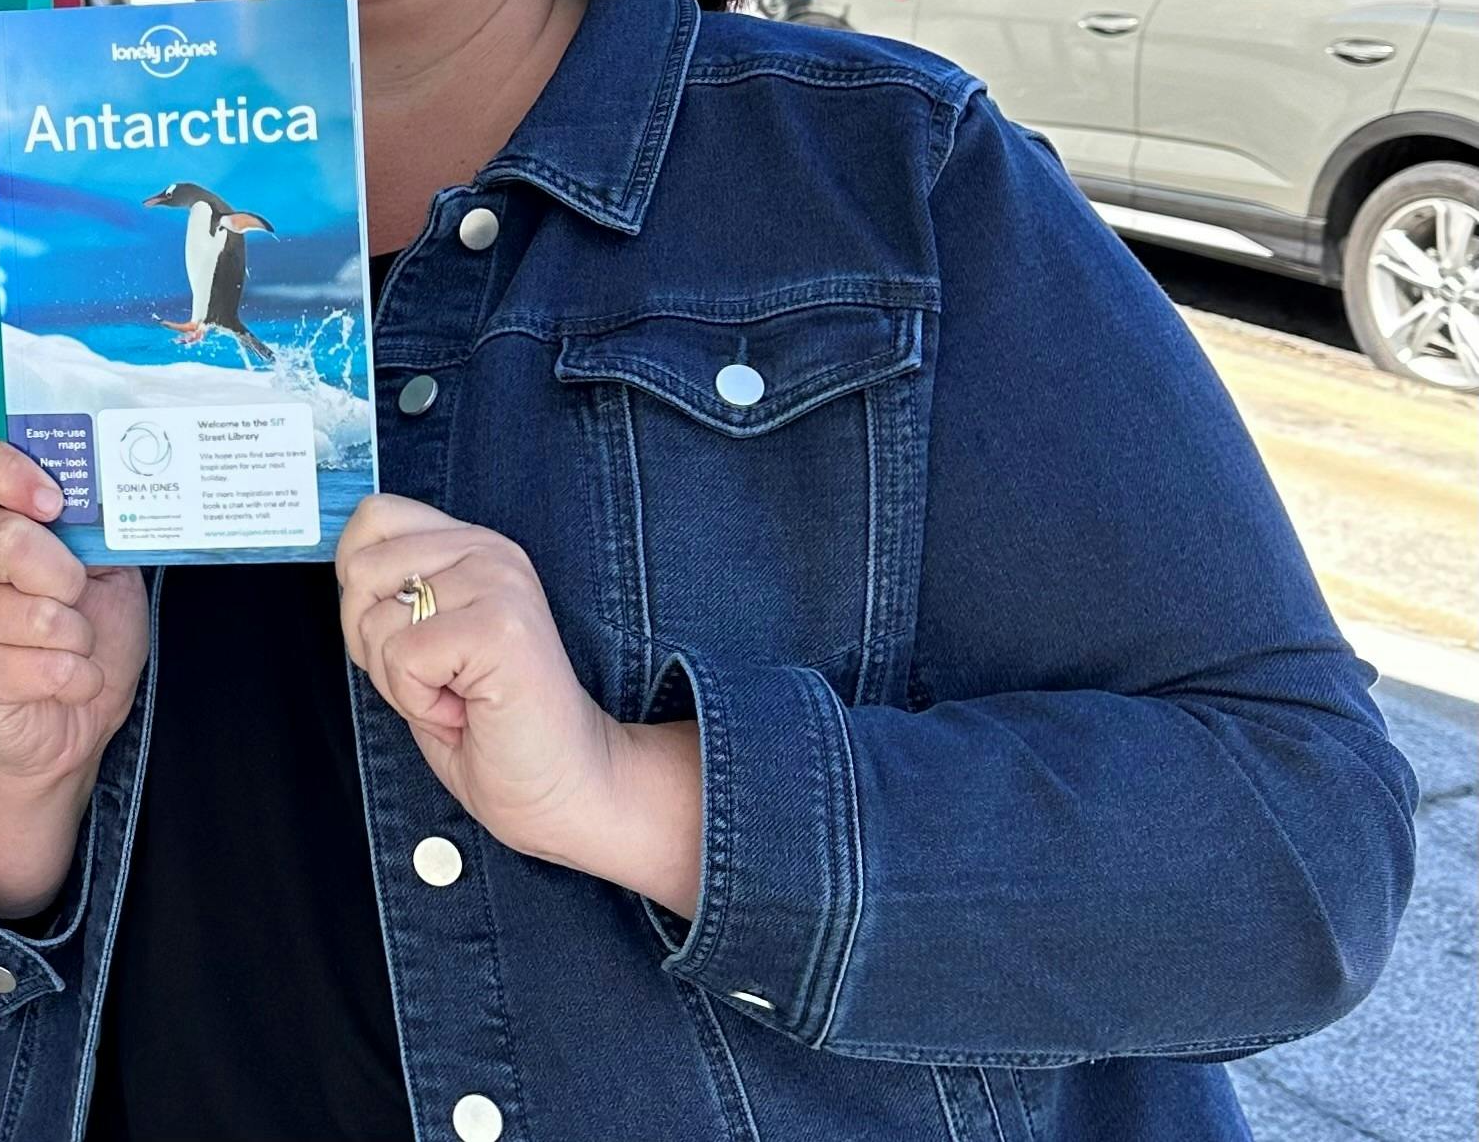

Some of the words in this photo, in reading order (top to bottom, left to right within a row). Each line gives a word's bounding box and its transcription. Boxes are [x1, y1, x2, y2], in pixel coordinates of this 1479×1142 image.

[112, 42, 162, 63] lonely
[163, 38, 218, 61] planet
[24, 96, 319, 153] Antarctica
[198, 420, 239, 429] Welcome
[253, 419, 268, 427] the
[26, 428, 87, 440] Easy-to-use
[198, 433, 225, 441] Street
[228, 432, 259, 442] Library
[58, 441, 87, 451] maps
[40, 458, 88, 467] New-look
[60, 469, 89, 481] guide
[64, 485, 90, 496] color
[150, 482, 181, 493] JONES
